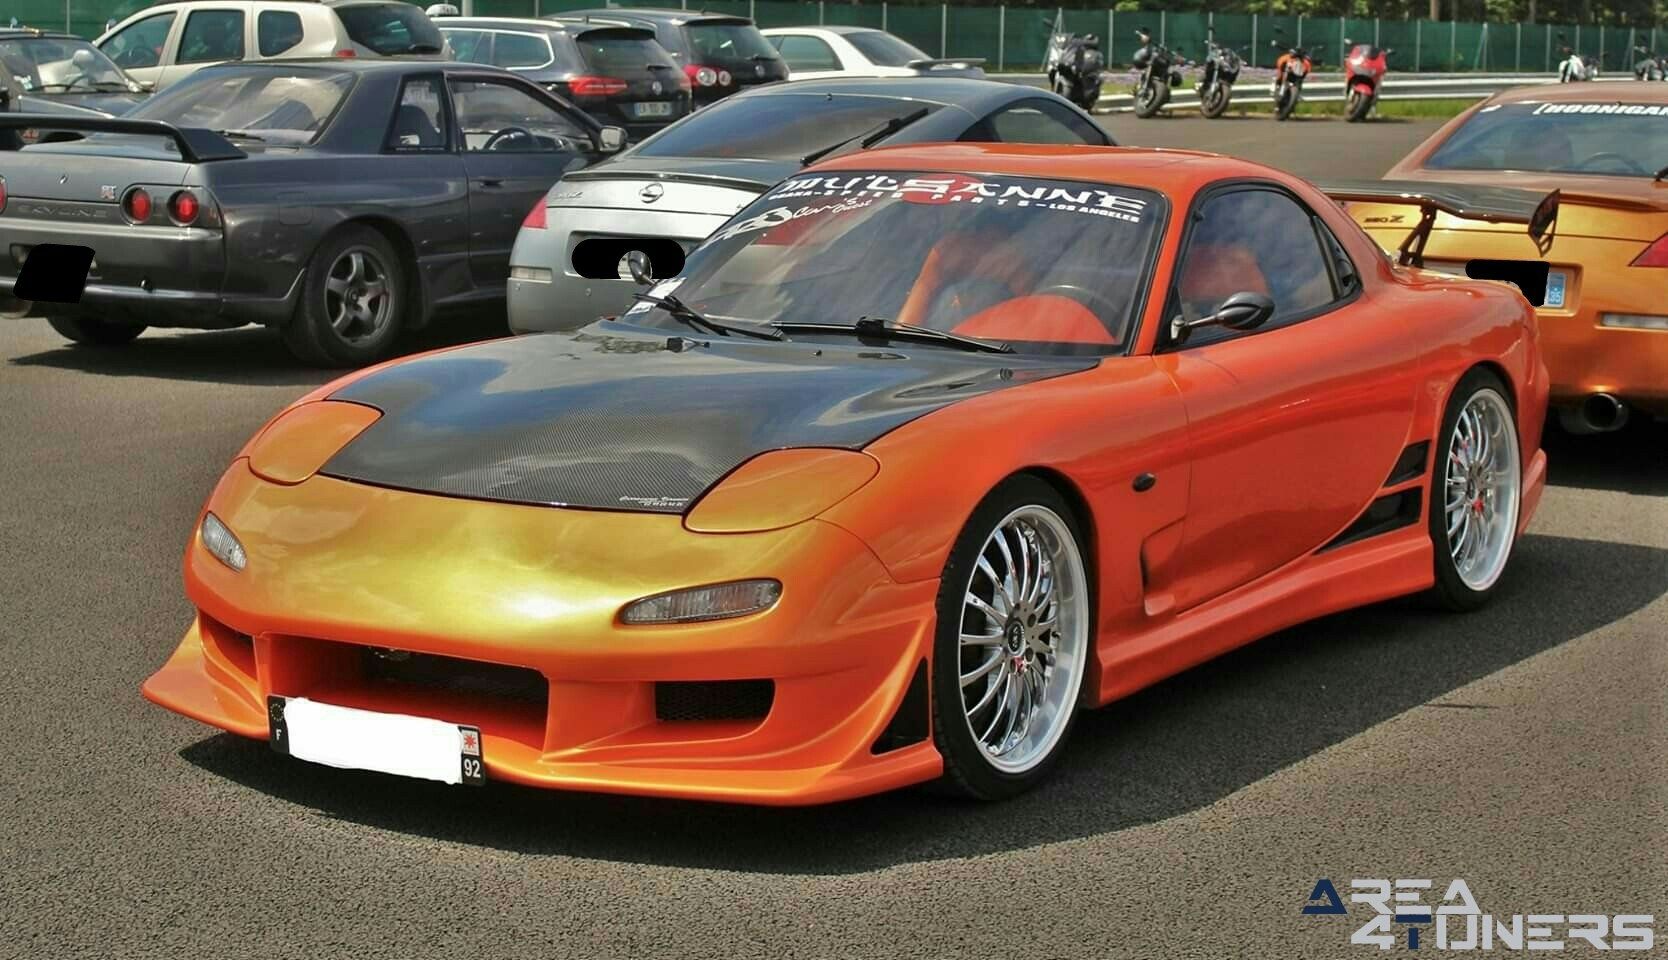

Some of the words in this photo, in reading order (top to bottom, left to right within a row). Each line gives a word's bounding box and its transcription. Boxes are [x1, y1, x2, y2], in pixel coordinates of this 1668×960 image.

[1078, 206, 1140, 223] ANGELES
[276, 728, 282, 741] F
[464, 759, 481, 778] 92
